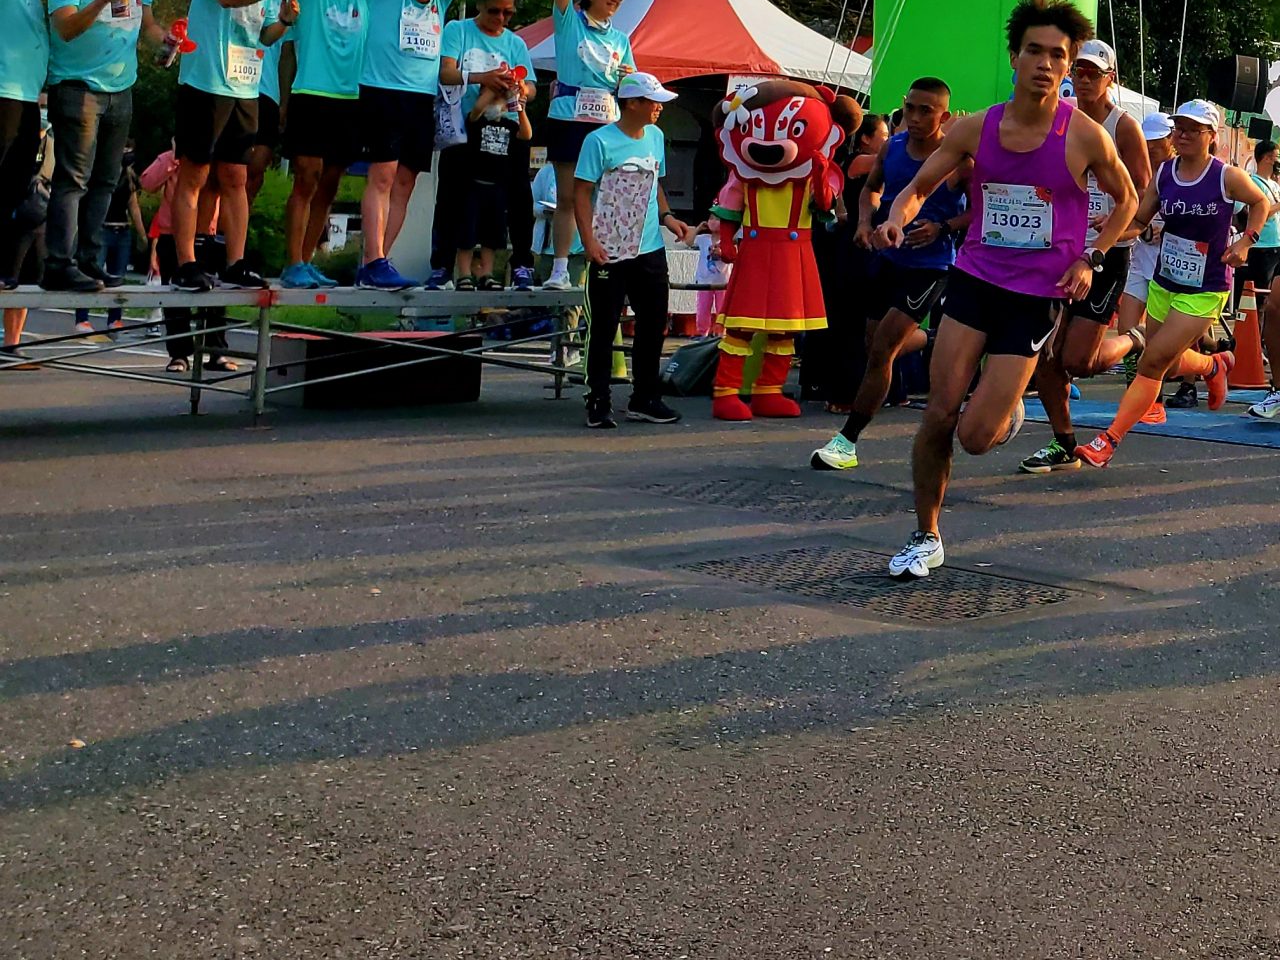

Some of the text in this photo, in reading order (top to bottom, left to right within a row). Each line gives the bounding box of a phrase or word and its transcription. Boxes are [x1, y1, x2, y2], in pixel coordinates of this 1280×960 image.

[233, 65, 257, 76] 11001
[991, 212, 1042, 229] 13023
[1165, 255, 1197, 272] 12033
